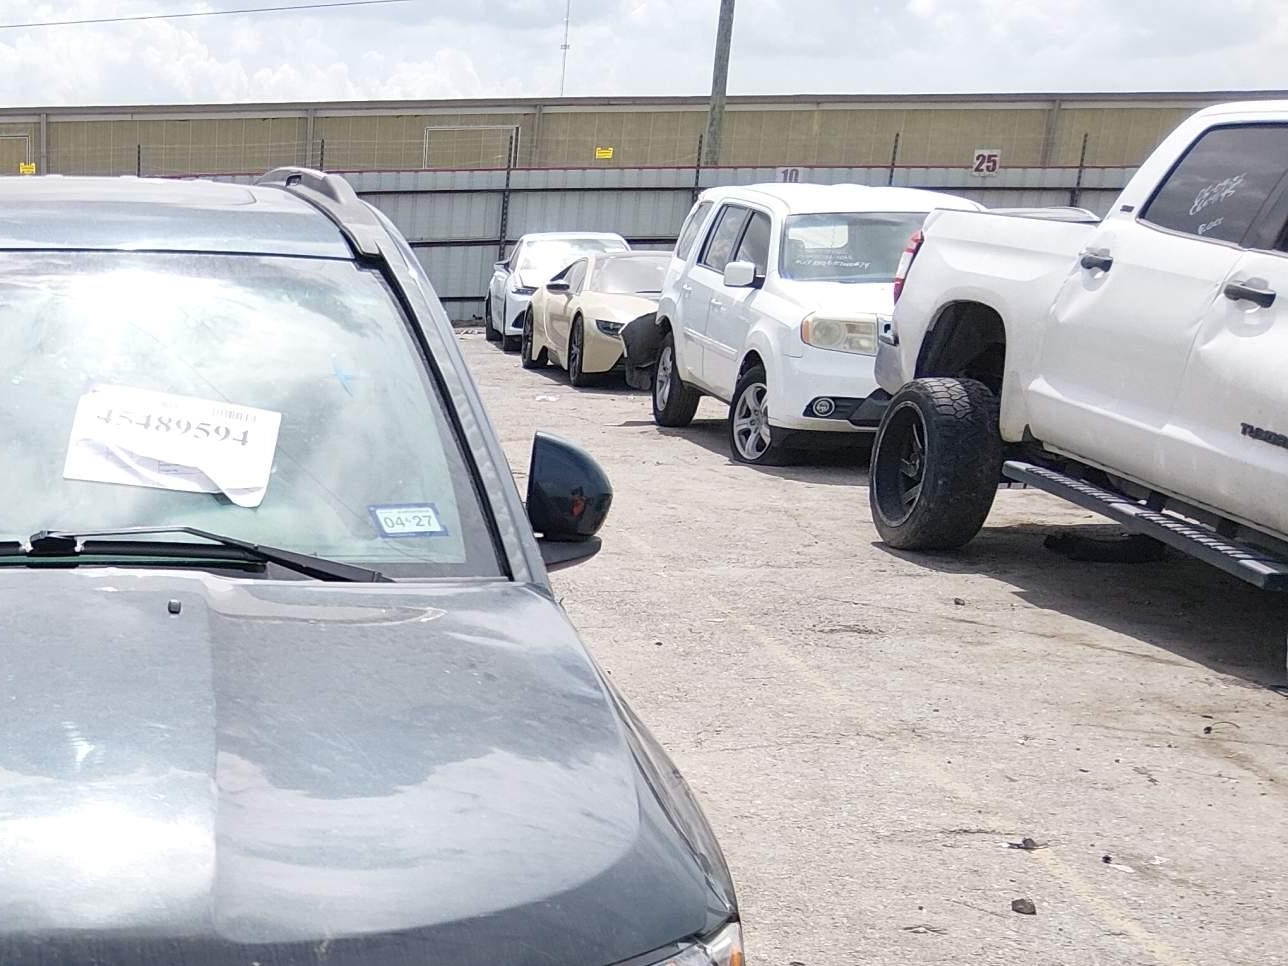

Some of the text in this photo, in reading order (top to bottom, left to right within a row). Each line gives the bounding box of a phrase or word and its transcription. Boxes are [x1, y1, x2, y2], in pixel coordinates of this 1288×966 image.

[974, 154, 997, 173] 25
[781, 168, 799, 183] 10
[383, 515, 433, 529] 04 27
